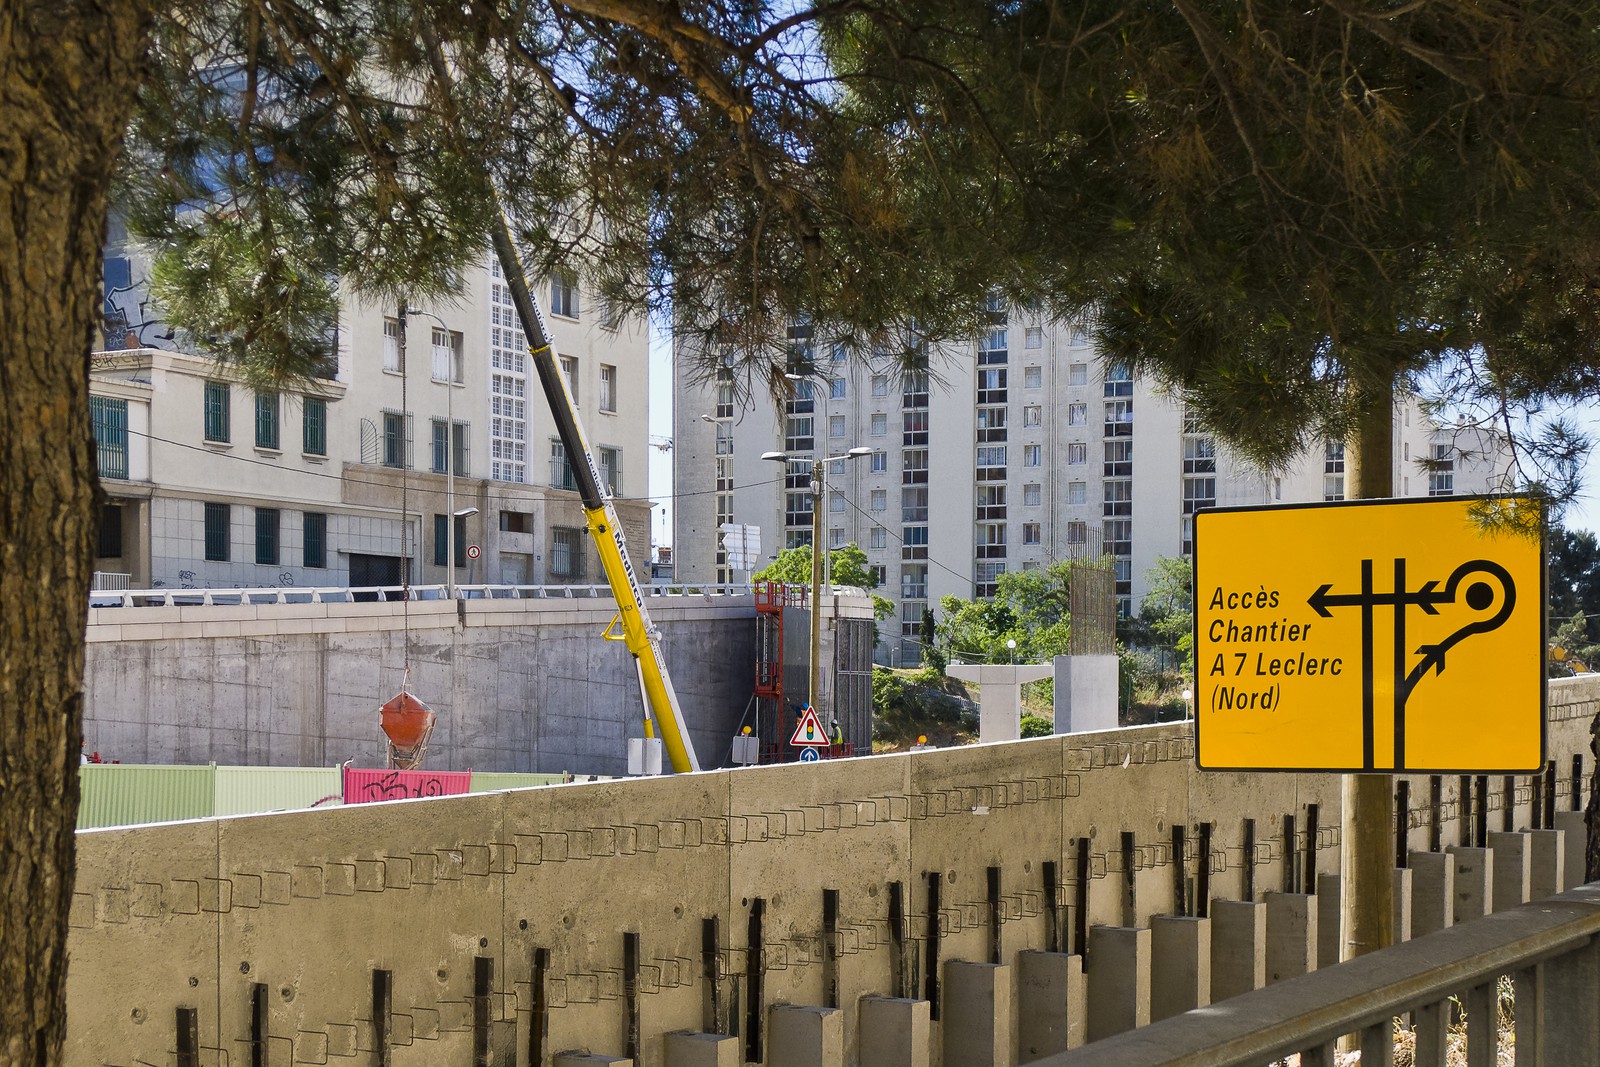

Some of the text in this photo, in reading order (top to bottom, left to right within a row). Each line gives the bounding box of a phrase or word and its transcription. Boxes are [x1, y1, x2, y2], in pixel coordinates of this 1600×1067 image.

[614, 531, 643, 608] Mediaco
[1208, 585, 1280, 611] Accès
[1208, 618, 1312, 643] Chantier
[1209, 651, 1343, 677] A 7 Leclerc
[1211, 683, 1280, 713] (Nord)
